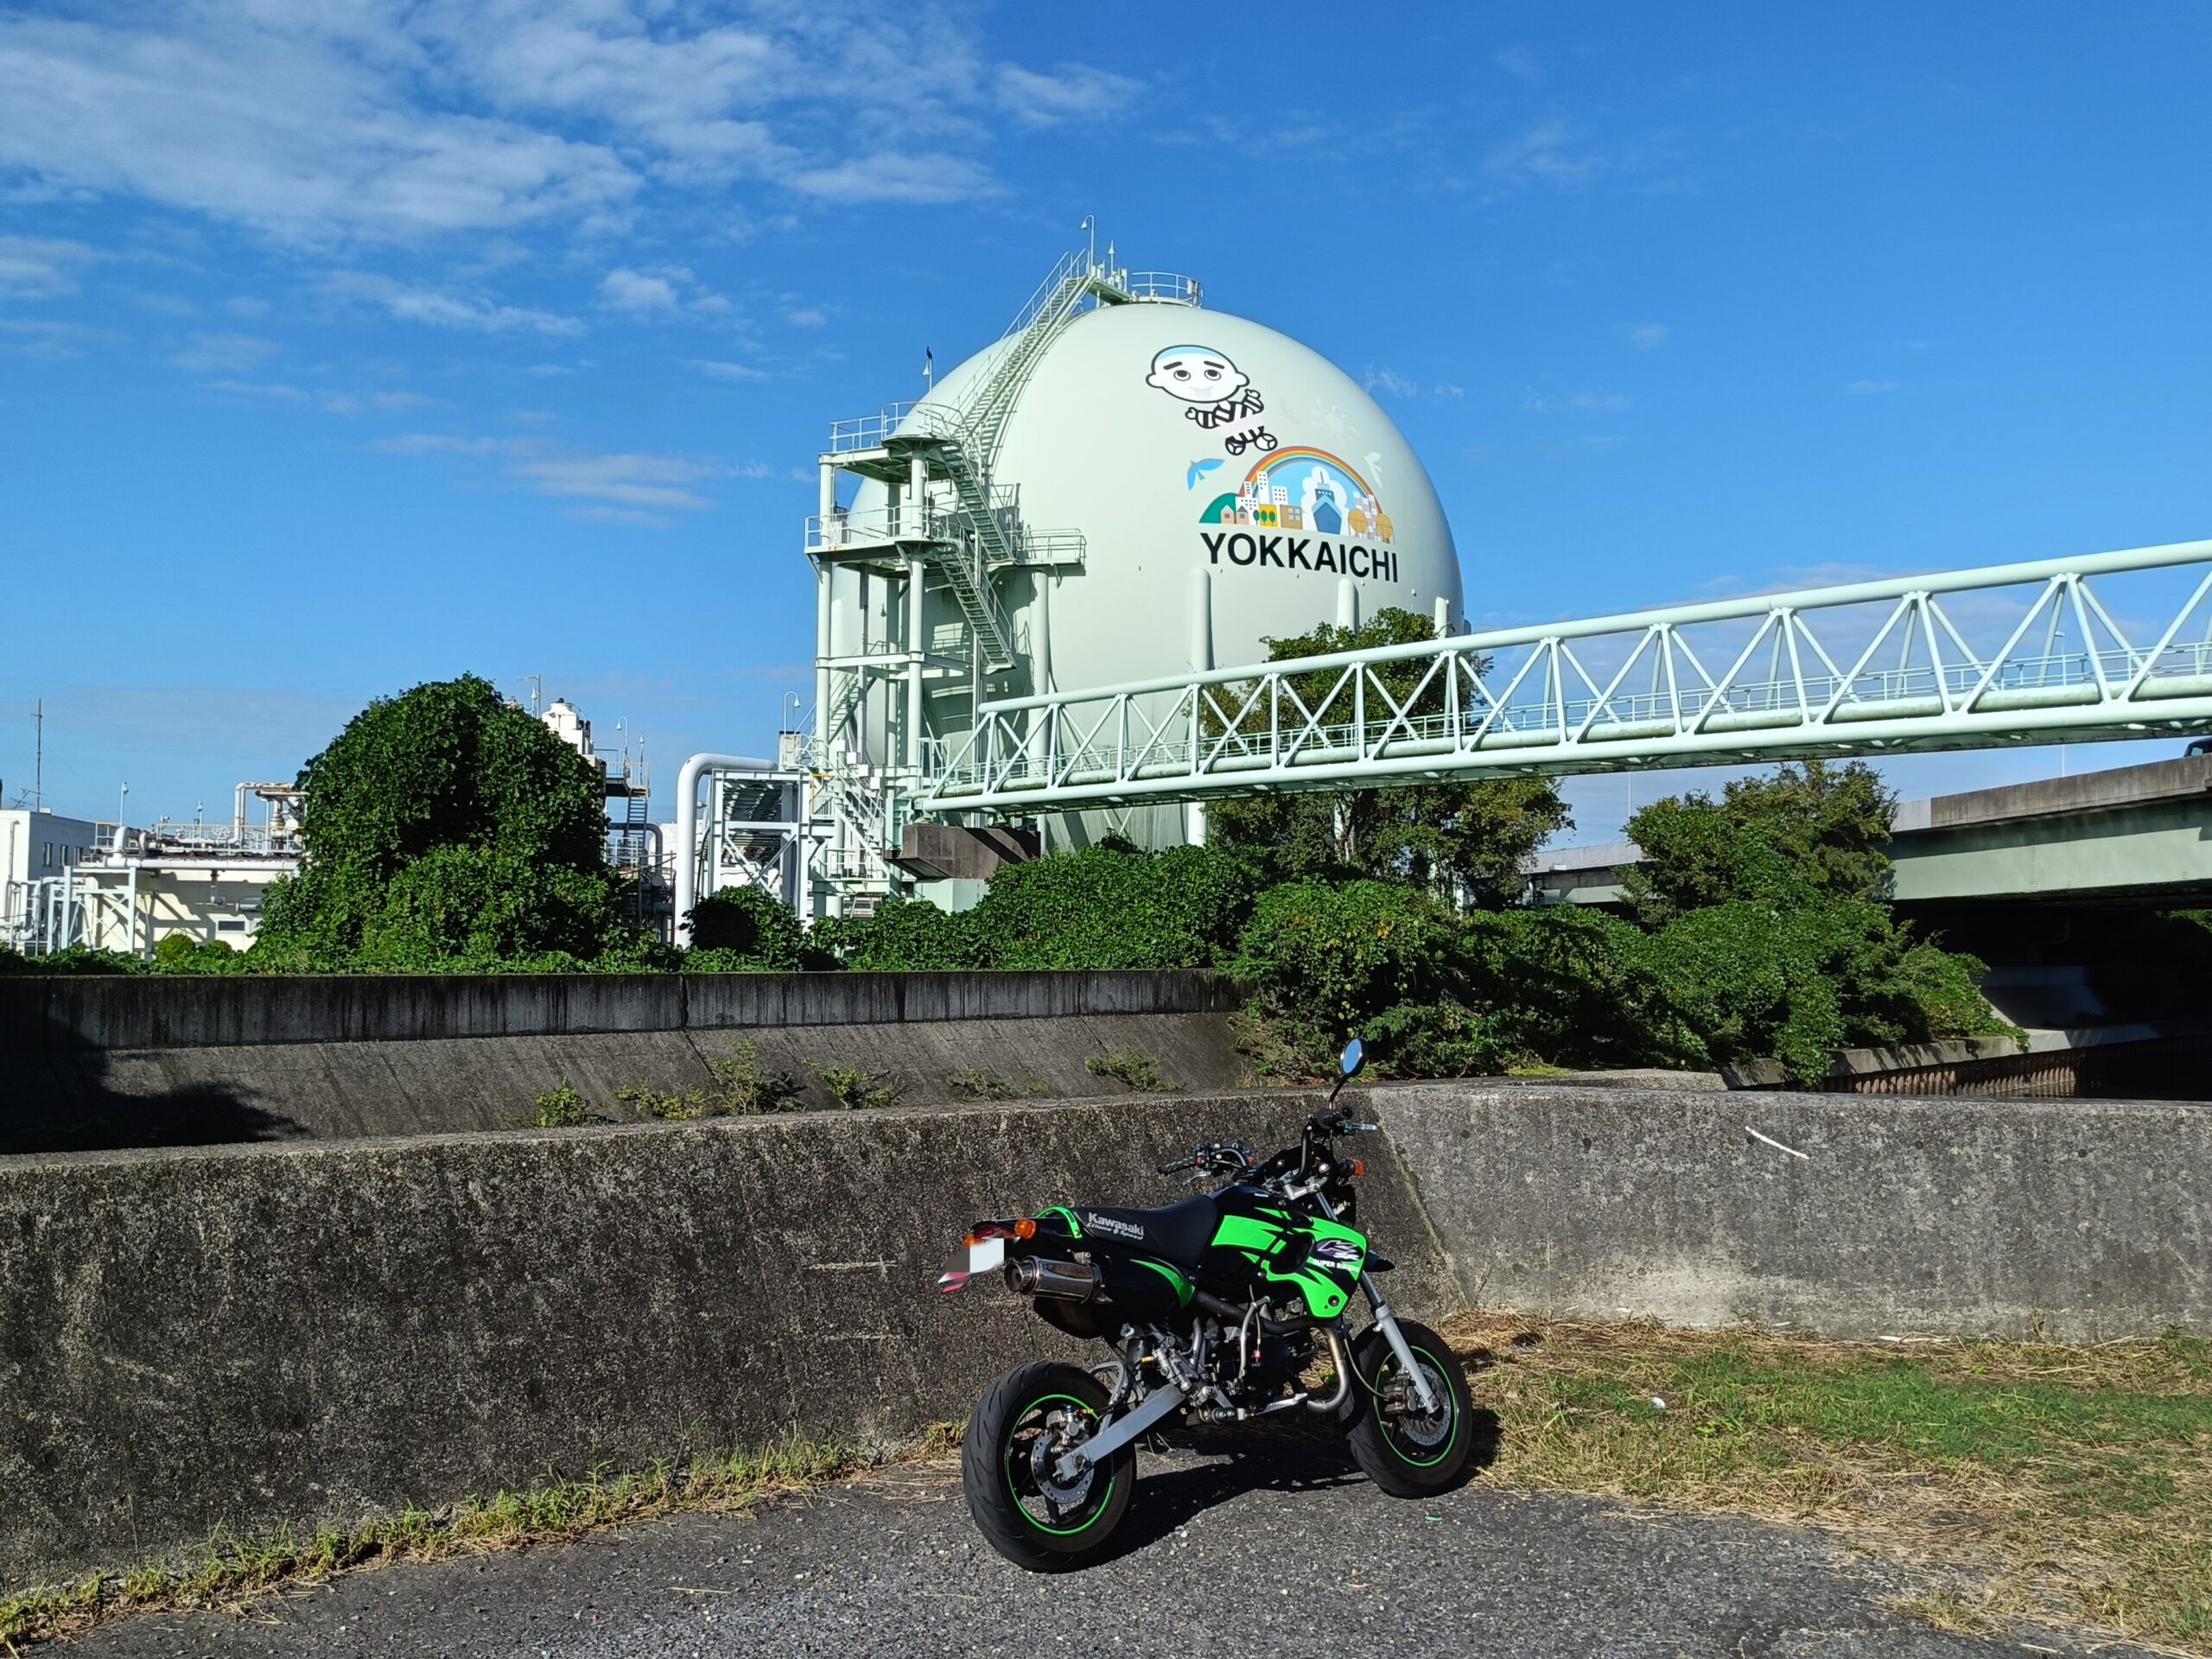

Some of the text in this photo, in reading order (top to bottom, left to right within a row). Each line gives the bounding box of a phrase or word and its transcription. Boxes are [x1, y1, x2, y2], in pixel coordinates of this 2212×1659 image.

[1200, 533, 1398, 582] YOKKAICHI
[1089, 1212, 1143, 1236] Kawasaki
[1313, 1258, 1335, 1268] SUPER
